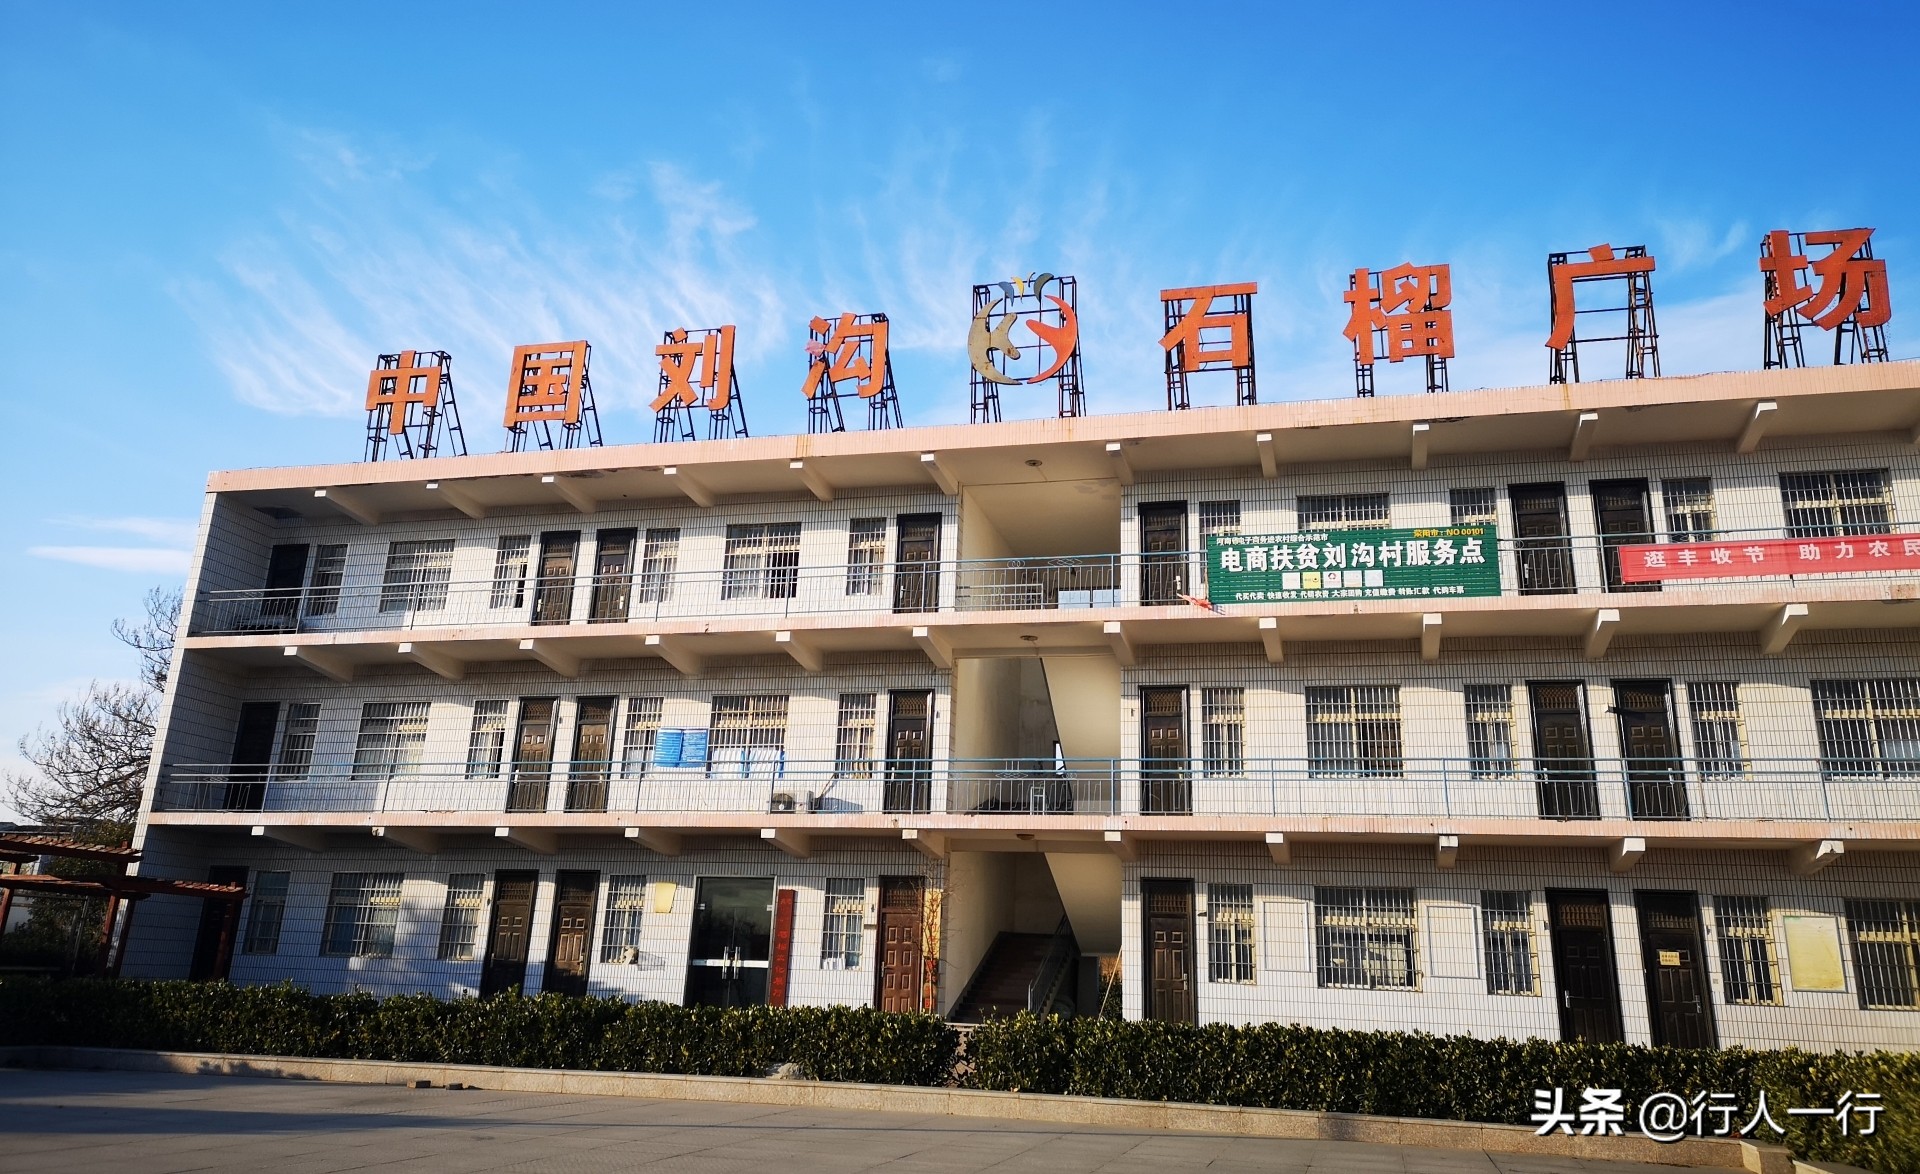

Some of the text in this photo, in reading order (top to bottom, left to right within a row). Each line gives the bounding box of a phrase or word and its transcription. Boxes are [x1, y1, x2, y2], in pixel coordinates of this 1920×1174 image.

[1158, 228, 1891, 371] 石榴广场
[1220, 537, 1486, 572] 电商扶贫刘沟村服务点
[1644, 546, 1765, 568] 逛丰收节
